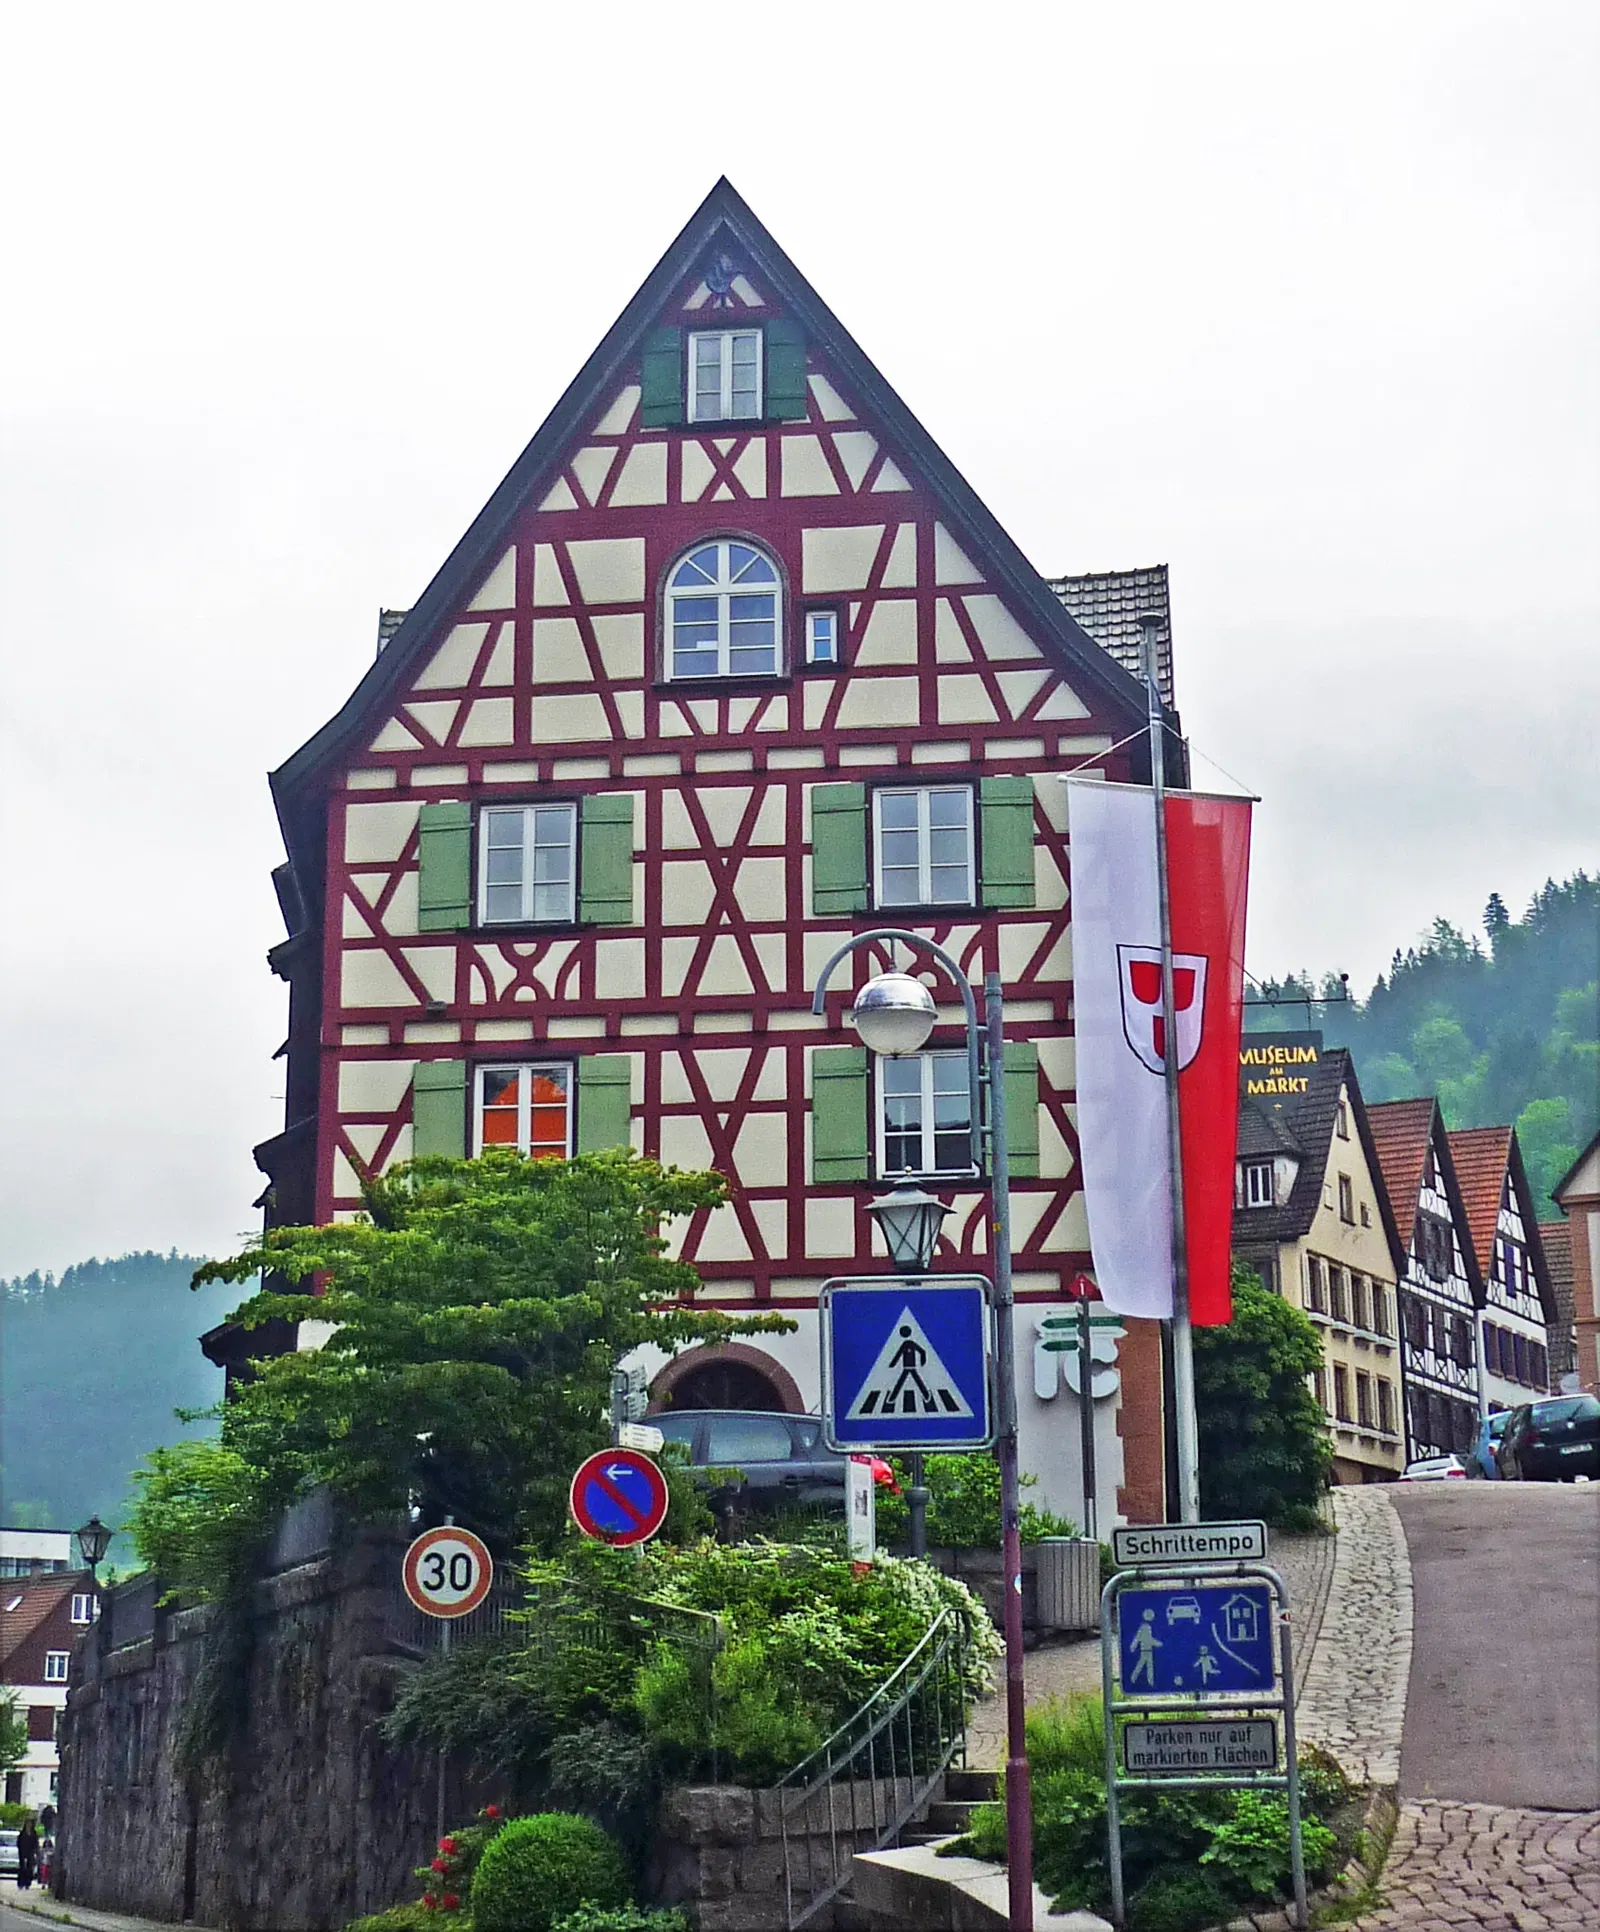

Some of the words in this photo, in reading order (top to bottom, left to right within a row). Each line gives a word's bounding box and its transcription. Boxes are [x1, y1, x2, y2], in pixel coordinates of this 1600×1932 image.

[1239, 1045, 1318, 1065] MUSEUM
[1269, 1067, 1284, 1076] AM
[1247, 1077, 1309, 1094] MARKT
[1126, 1534, 1254, 1556] Schrittempo
[423, 1552, 473, 1592] 30
[1146, 1728, 1193, 1745] Parken
[1199, 1730, 1223, 1744] nur
[1229, 1726, 1253, 1744] auf
[1133, 1748, 1208, 1765] markierten
[1214, 1745, 1268, 1763] Flächen
